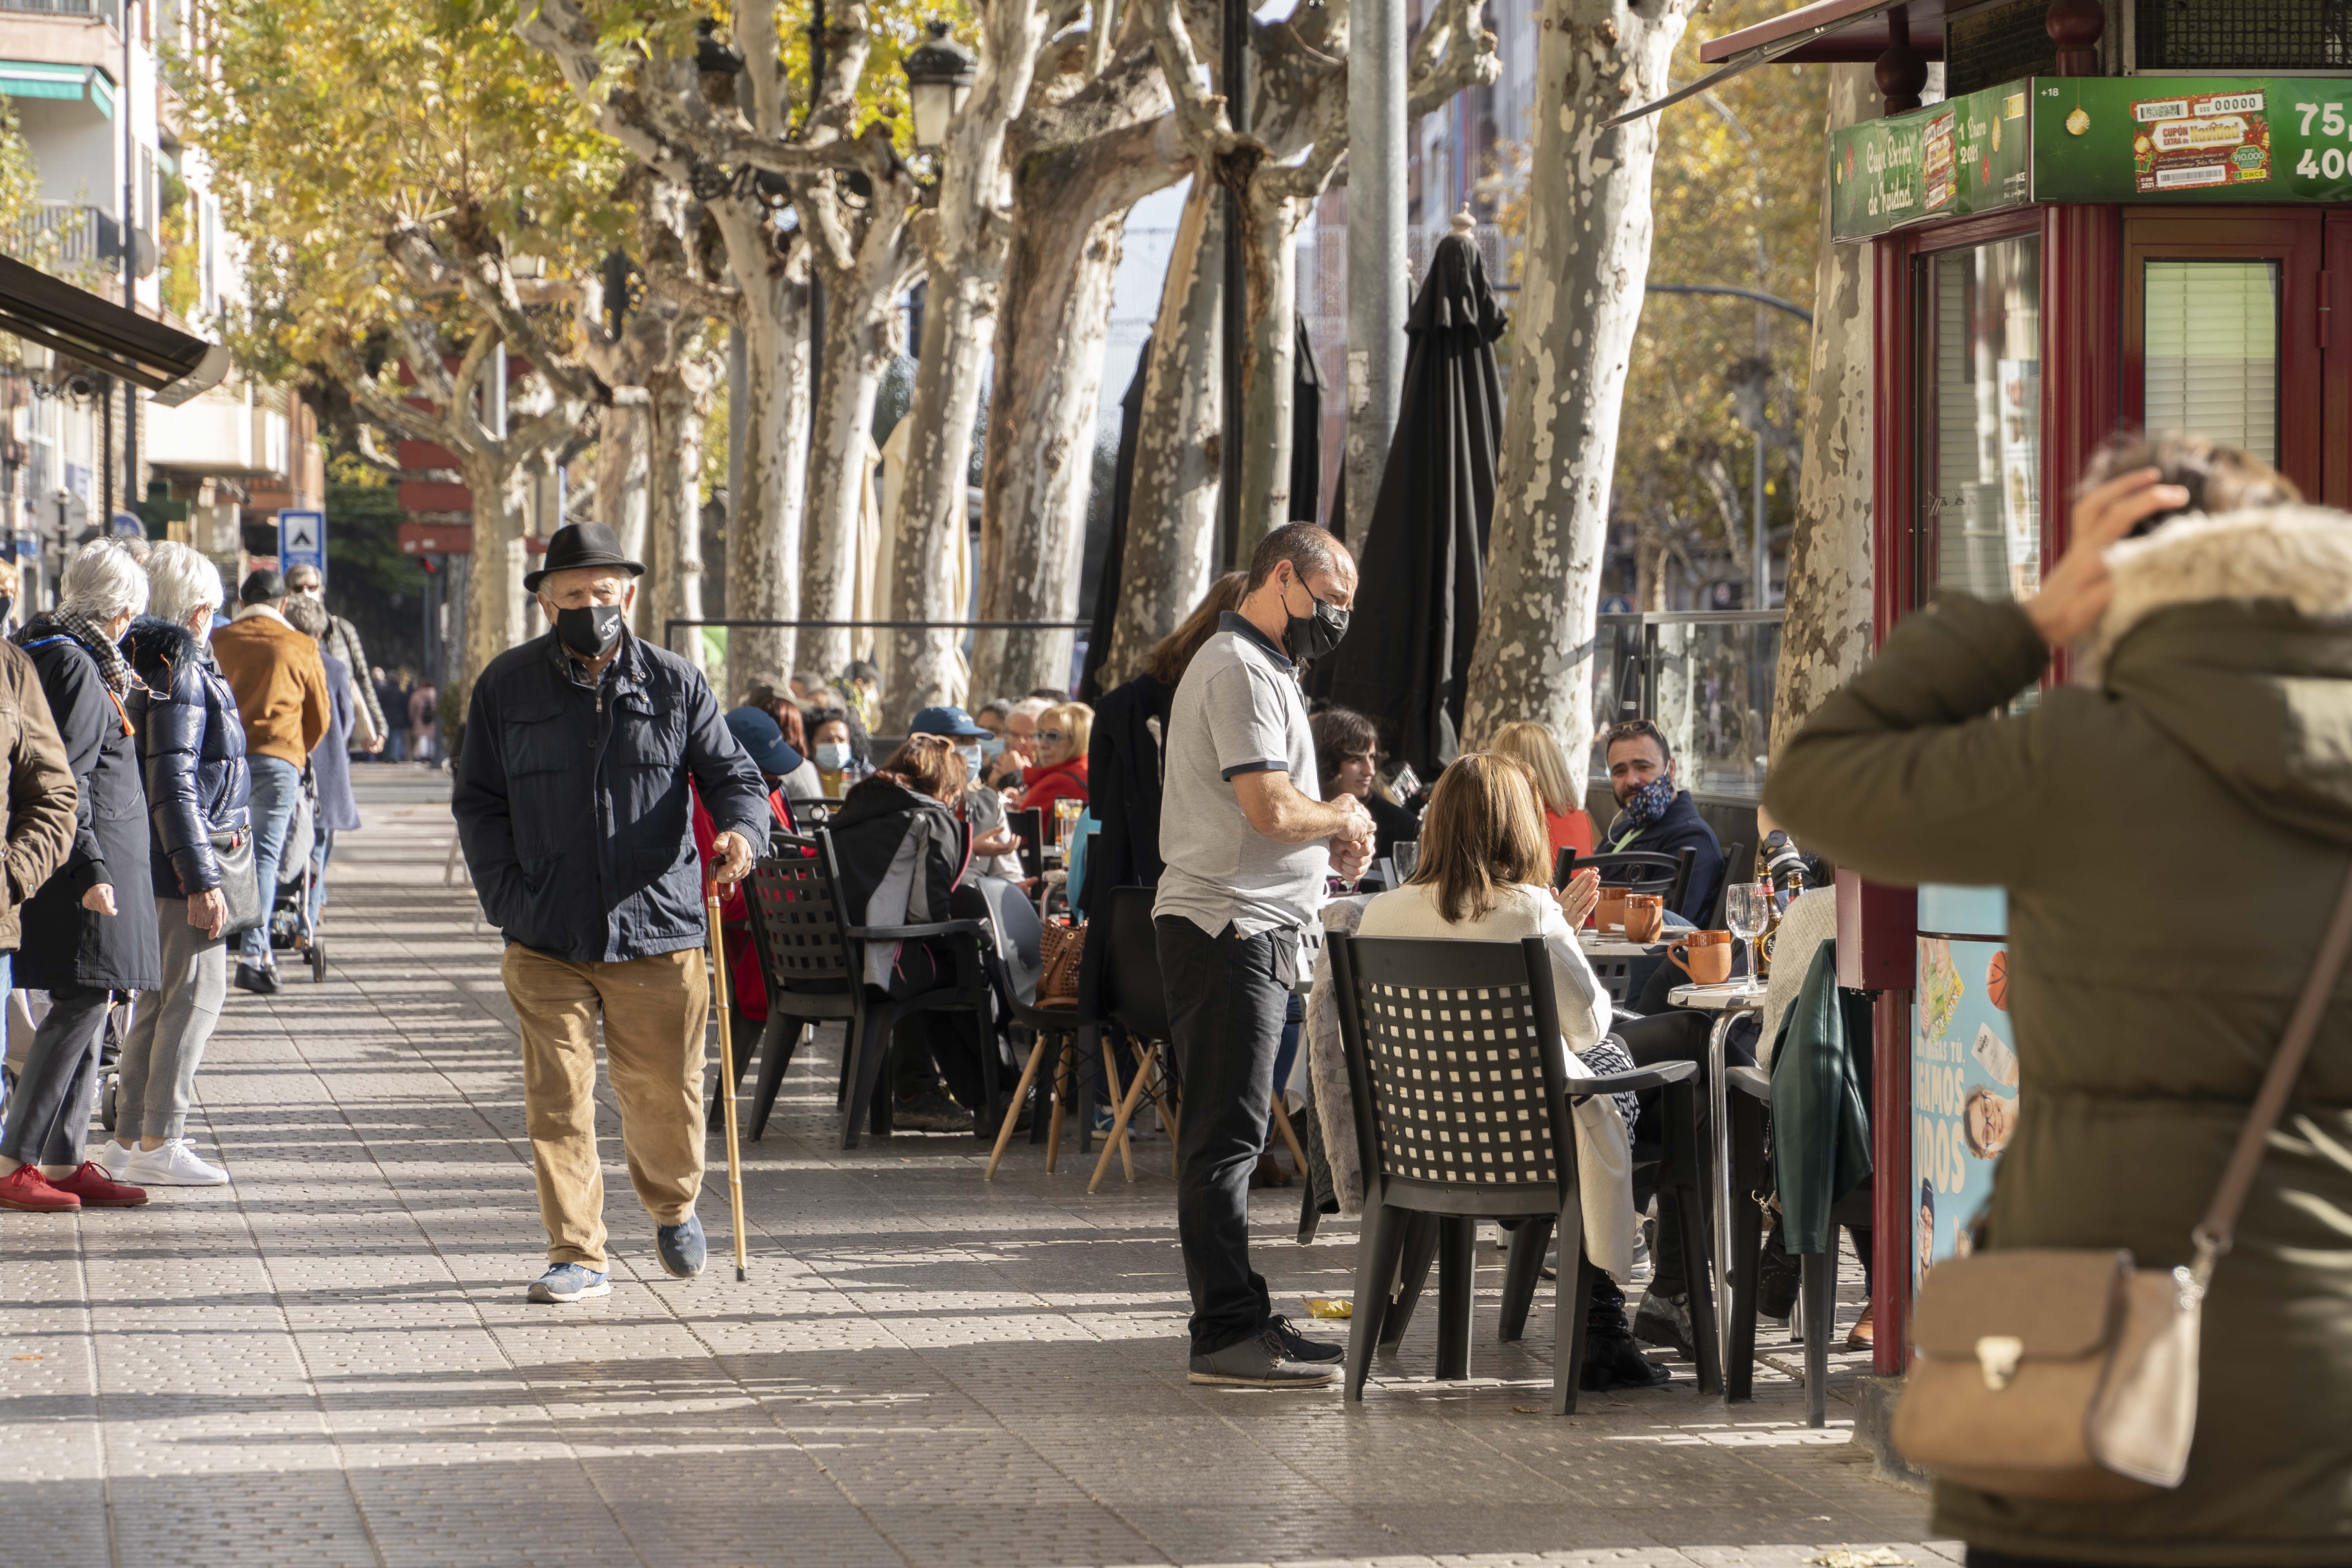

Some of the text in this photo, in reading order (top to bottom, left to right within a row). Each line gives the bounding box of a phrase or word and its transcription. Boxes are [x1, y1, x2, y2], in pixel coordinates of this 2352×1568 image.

[2041, 88, 2059, 96] +18
[2216, 98, 2256, 111] 00000
[1959, 123, 1964, 140] 1
[1967, 116, 1986, 139] Enero
[2163, 122, 2239, 142] CUPÓN Navidad
[1887, 135, 1912, 168] Extra
[1960, 144, 1978, 164] 2021
[2233, 152, 2265, 162] 910.000
[2296, 148, 2352, 179] 40
[1868, 184, 1878, 216] de
[1916, 1113, 1965, 1194] ODOS
